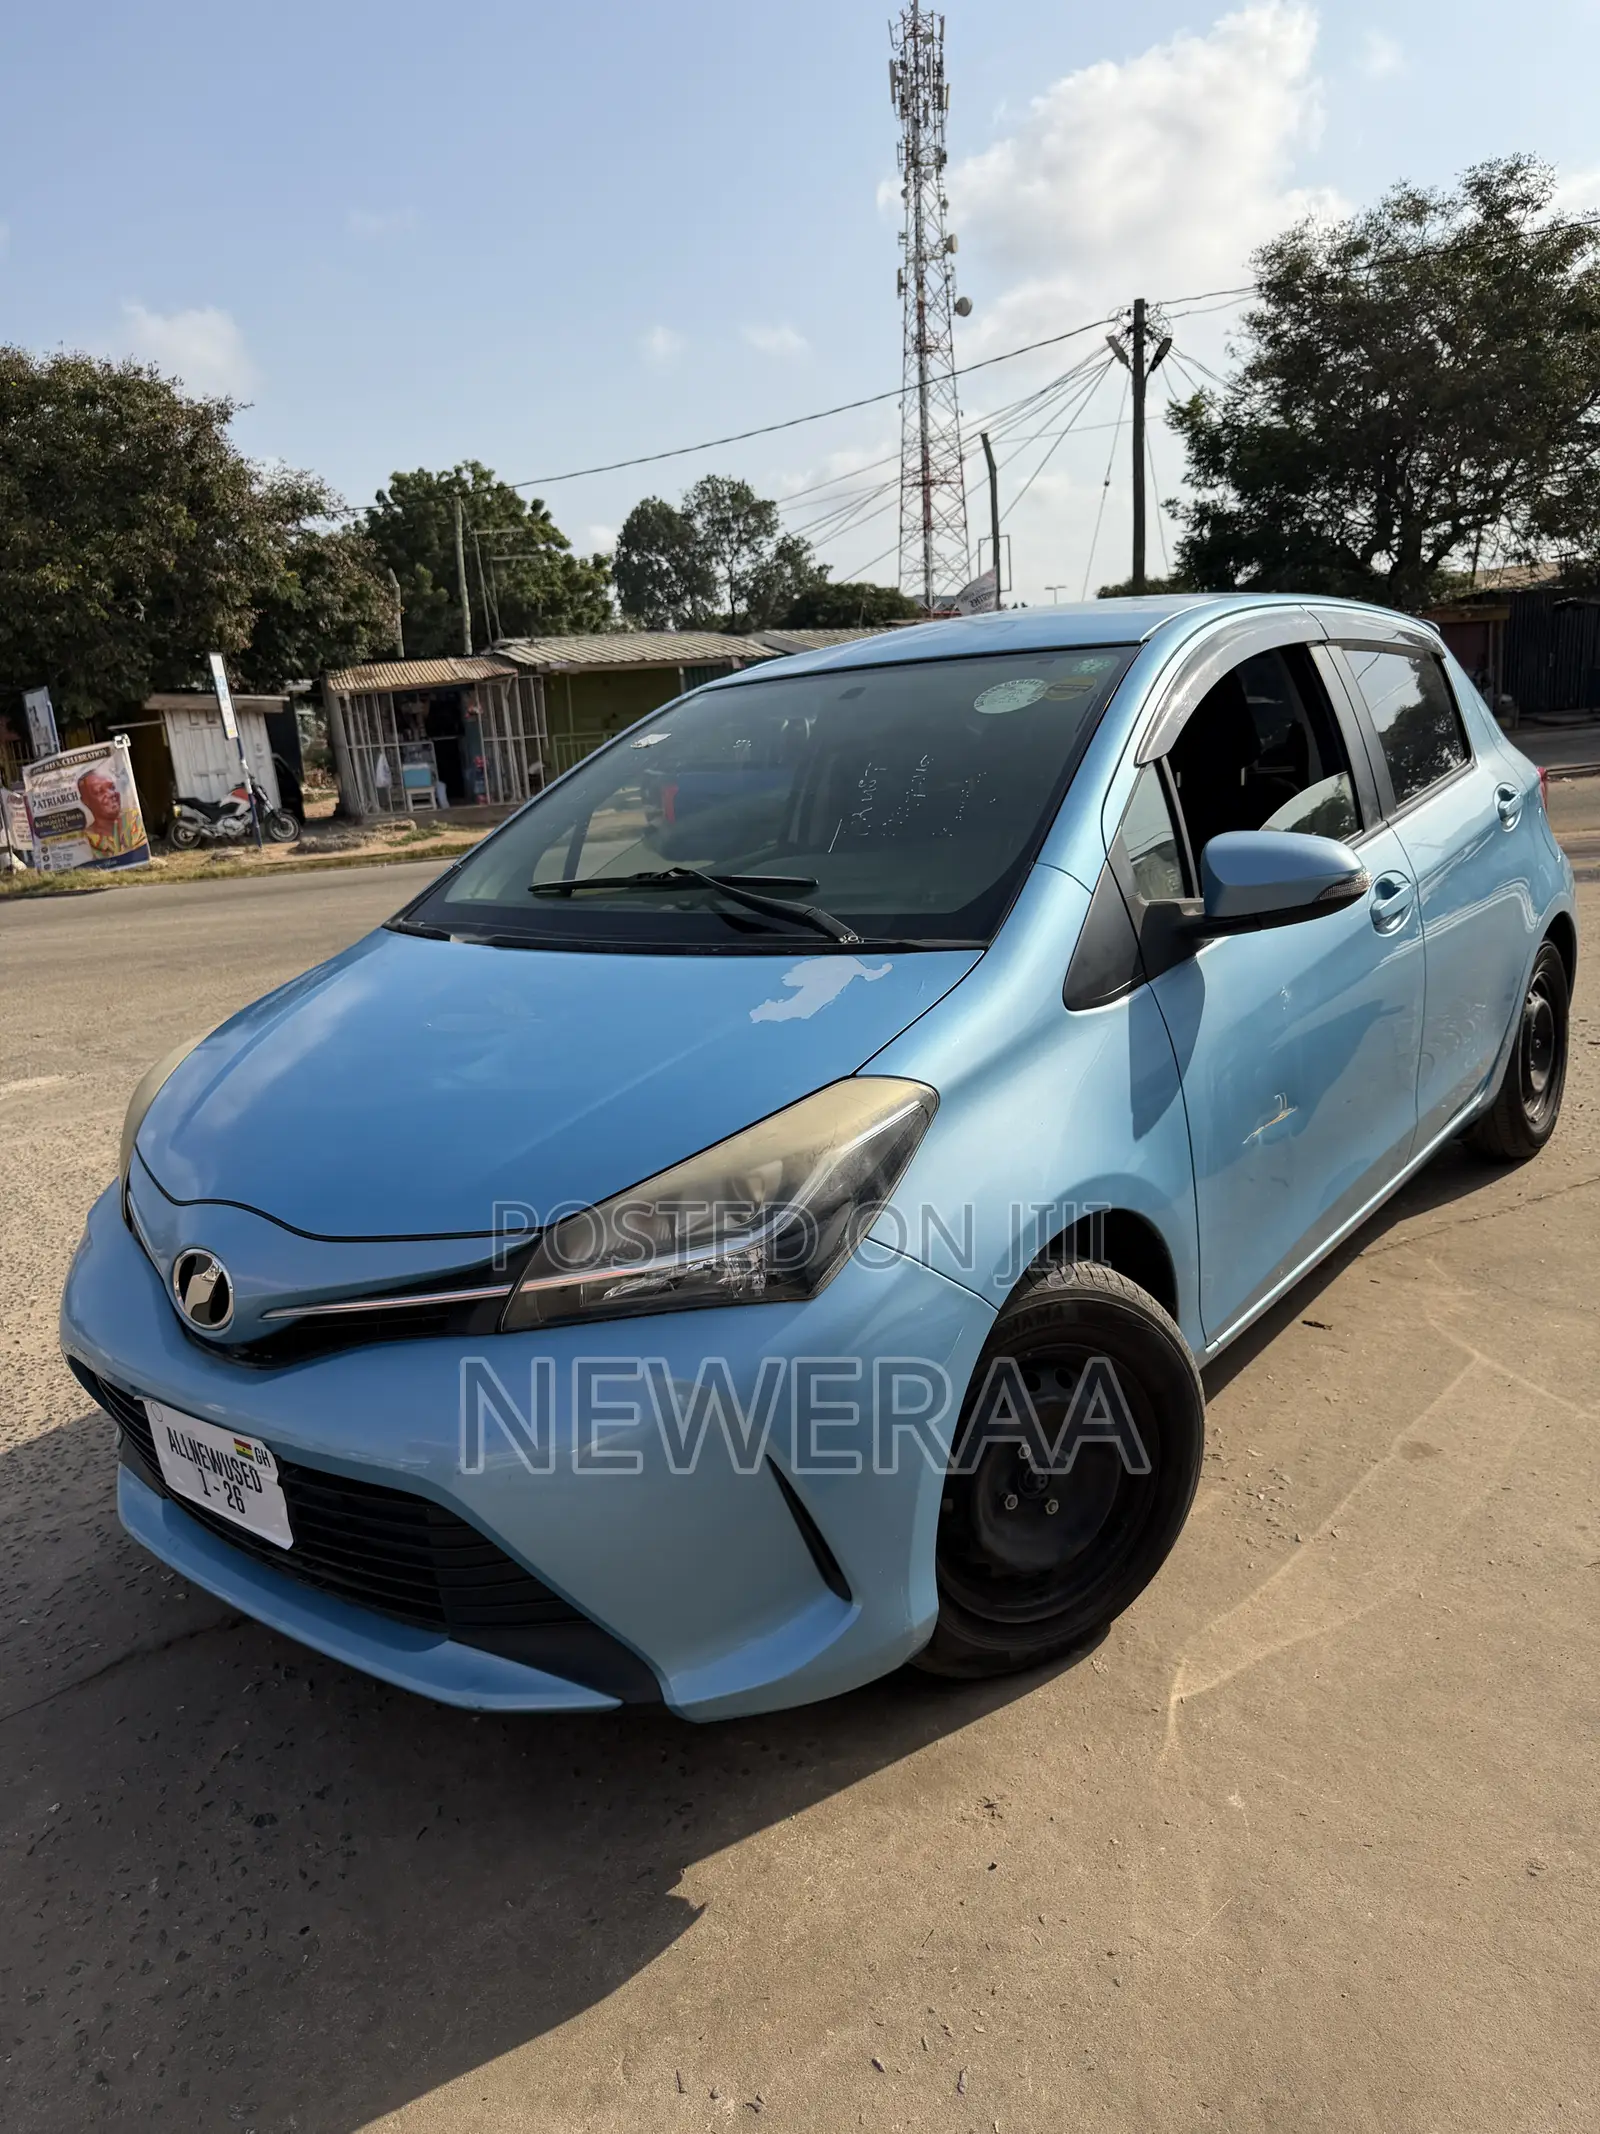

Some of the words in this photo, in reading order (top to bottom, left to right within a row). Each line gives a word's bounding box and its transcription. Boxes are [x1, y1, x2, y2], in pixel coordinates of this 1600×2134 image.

[32, 791, 79, 813] PATRIARCH
[166, 1426, 263, 1494] ALLNEWUSED
[254, 1446, 271, 1468] GH
